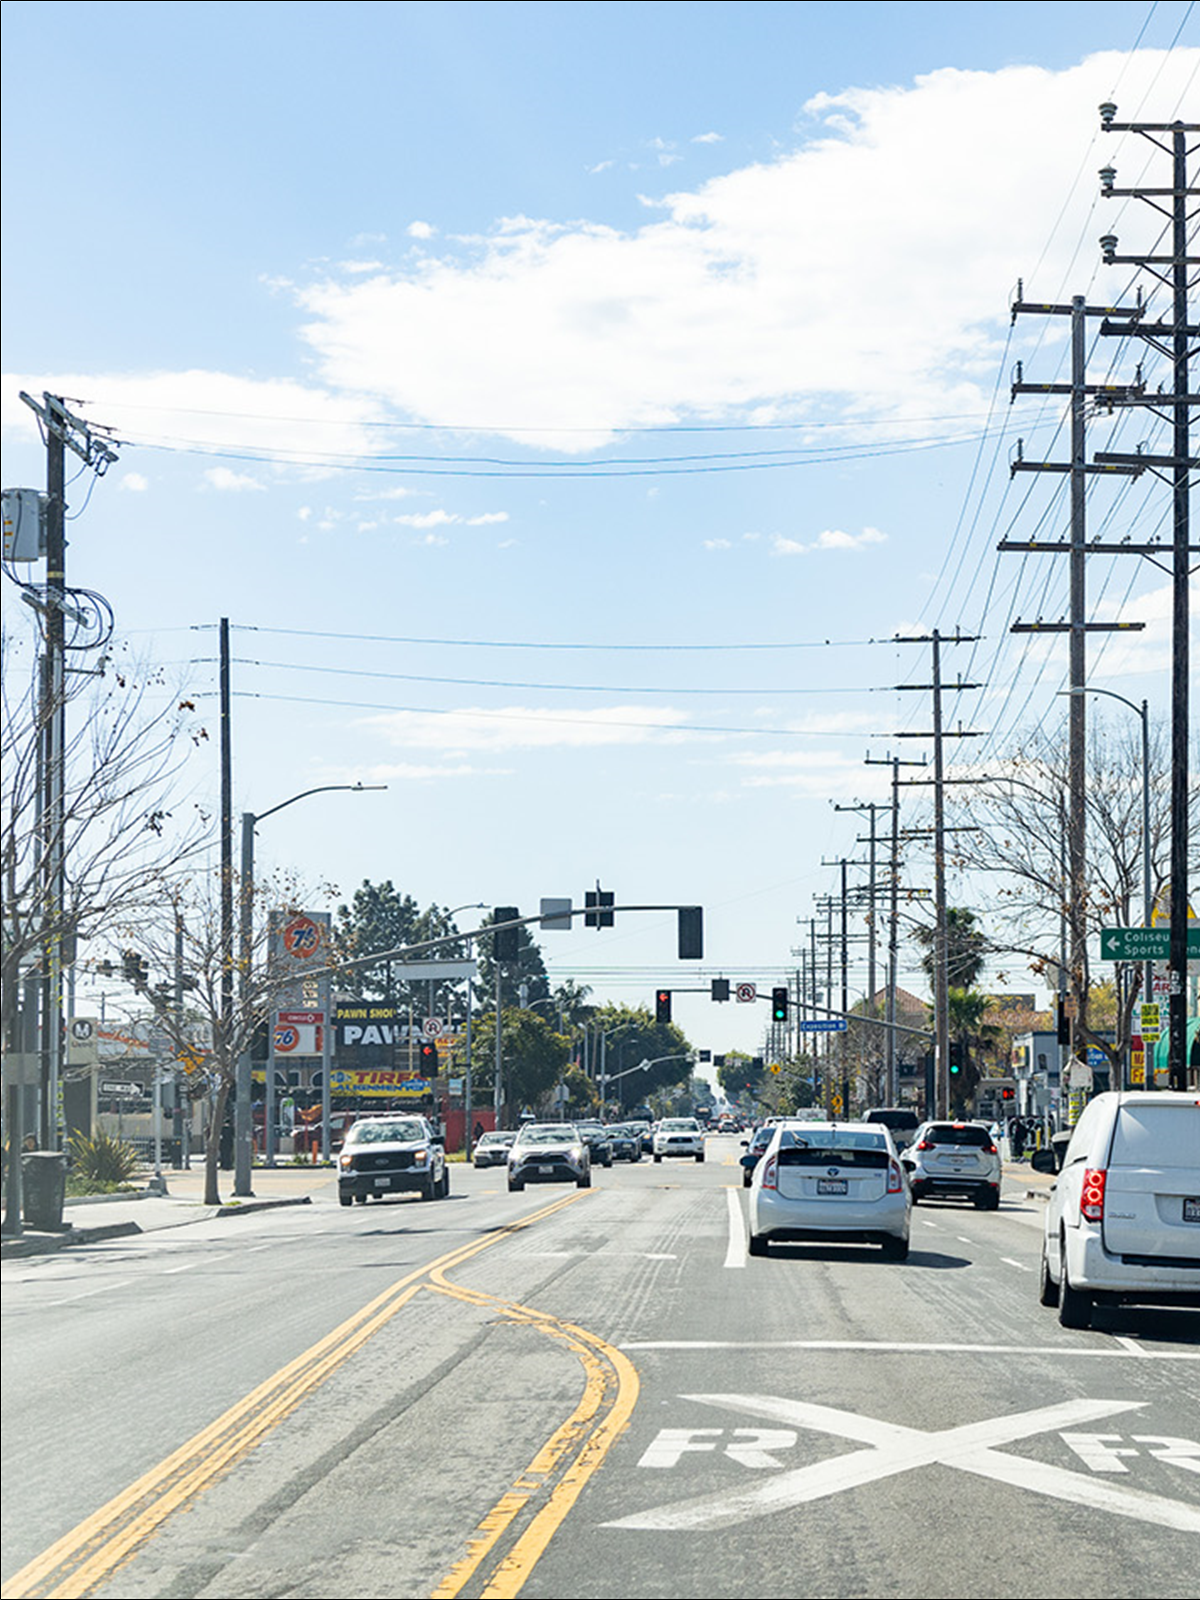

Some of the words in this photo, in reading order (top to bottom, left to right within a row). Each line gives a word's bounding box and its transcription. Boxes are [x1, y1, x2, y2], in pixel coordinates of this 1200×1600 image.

[292, 926, 317, 949] 76
[1124, 932, 1170, 943] Coliseu
[1124, 944, 1165, 956] Sports
[337, 1009, 368, 1019] PAWN
[273, 1030, 294, 1046] 76
